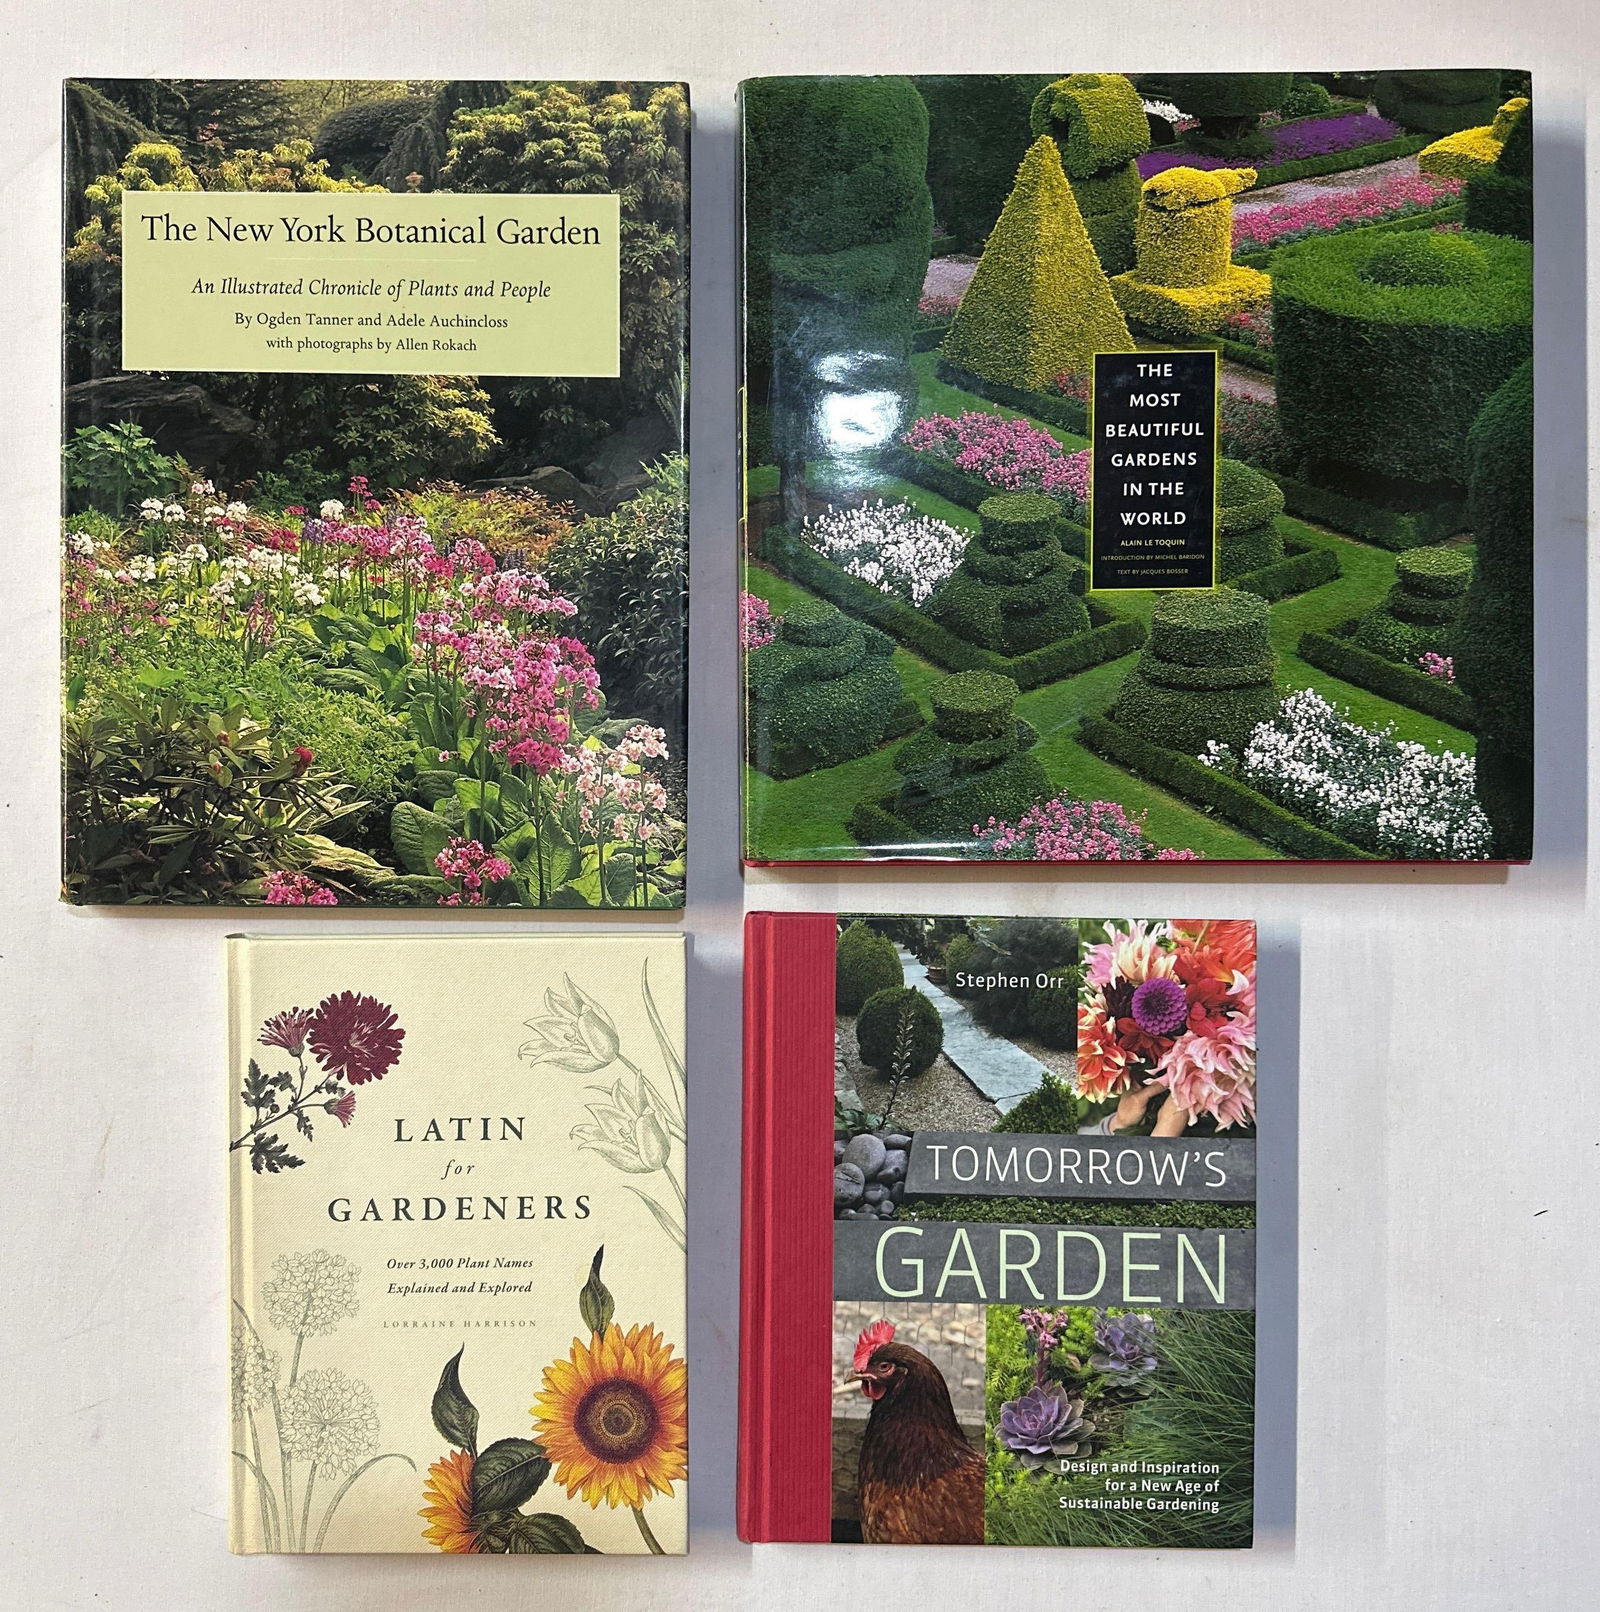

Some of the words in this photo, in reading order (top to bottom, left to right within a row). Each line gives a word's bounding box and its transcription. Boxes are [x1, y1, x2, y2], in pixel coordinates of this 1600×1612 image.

[141, 213, 198, 242] The
[206, 216, 274, 242] New
[278, 214, 346, 243] York
[355, 216, 485, 245] Botanical
[496, 218, 601, 246] Garden
[191, 279, 215, 294] An
[220, 276, 304, 296] Illustrated
[308, 278, 382, 297] Chronicle
[386, 278, 406, 302] of
[408, 279, 459, 298] Plants
[464, 280, 495, 298] and
[500, 281, 551, 303] People
[235, 312, 252, 329] By
[256, 312, 302, 329] Ogden
[306, 313, 354, 327] Tanner
[357, 313, 382, 327] and
[386, 313, 425, 327] Adele
[430, 314, 509, 328] Auchincloss
[266, 336, 293, 349] with
[296, 336, 374, 353] photographs
[376, 337, 392, 353] by
[395, 338, 429, 351] Allen
[432, 338, 477, 352] Rokach
[1137, 363, 1173, 378] THE
[1129, 393, 1181, 408] MOST
[1105, 422, 1204, 438] BEAUTIFUL
[1111, 452, 1197, 467] GARDENS
[1123, 482, 1143, 497] IN
[1148, 482, 1184, 496] THE
[1120, 511, 1187, 526] WORLD
[1120, 539, 1143, 547] ALAIN
[1154, 538, 1185, 547] TOQUIN
[956, 971, 1030, 992] Stephen
[1035, 973, 1064, 989] Orr
[394, 1116, 526, 1143] LATIN
[440, 1159, 475, 1180] for
[328, 1195, 591, 1222] GARDENERS
[386, 1258, 416, 1269] Over
[418, 1258, 454, 1270] 3,000
[456, 1258, 490, 1269] Plant
[493, 1258, 534, 1268] Names
[875, 1225, 1226, 1304] GARDEN
[387, 1282, 448, 1296] Explained
[451, 1282, 476, 1293] and
[478, 1281, 533, 1296] Explored
[383, 1320, 456, 1329] LORRAINE
[464, 1320, 537, 1328] HARRISON
[1060, 1459, 1108, 1475] Design
[1111, 1461, 1137, 1473] and
[1141, 1461, 1220, 1476] Inspiration
[1105, 1478, 1126, 1491] for
[1129, 1482, 1137, 1492] a
[1141, 1479, 1172, 1492] New
[1175, 1480, 1201, 1495] Age
[1204, 1480, 1220, 1492] of
[1059, 1496, 1143, 1510] Sustainable
[1146, 1498, 1220, 1513] Gardening
